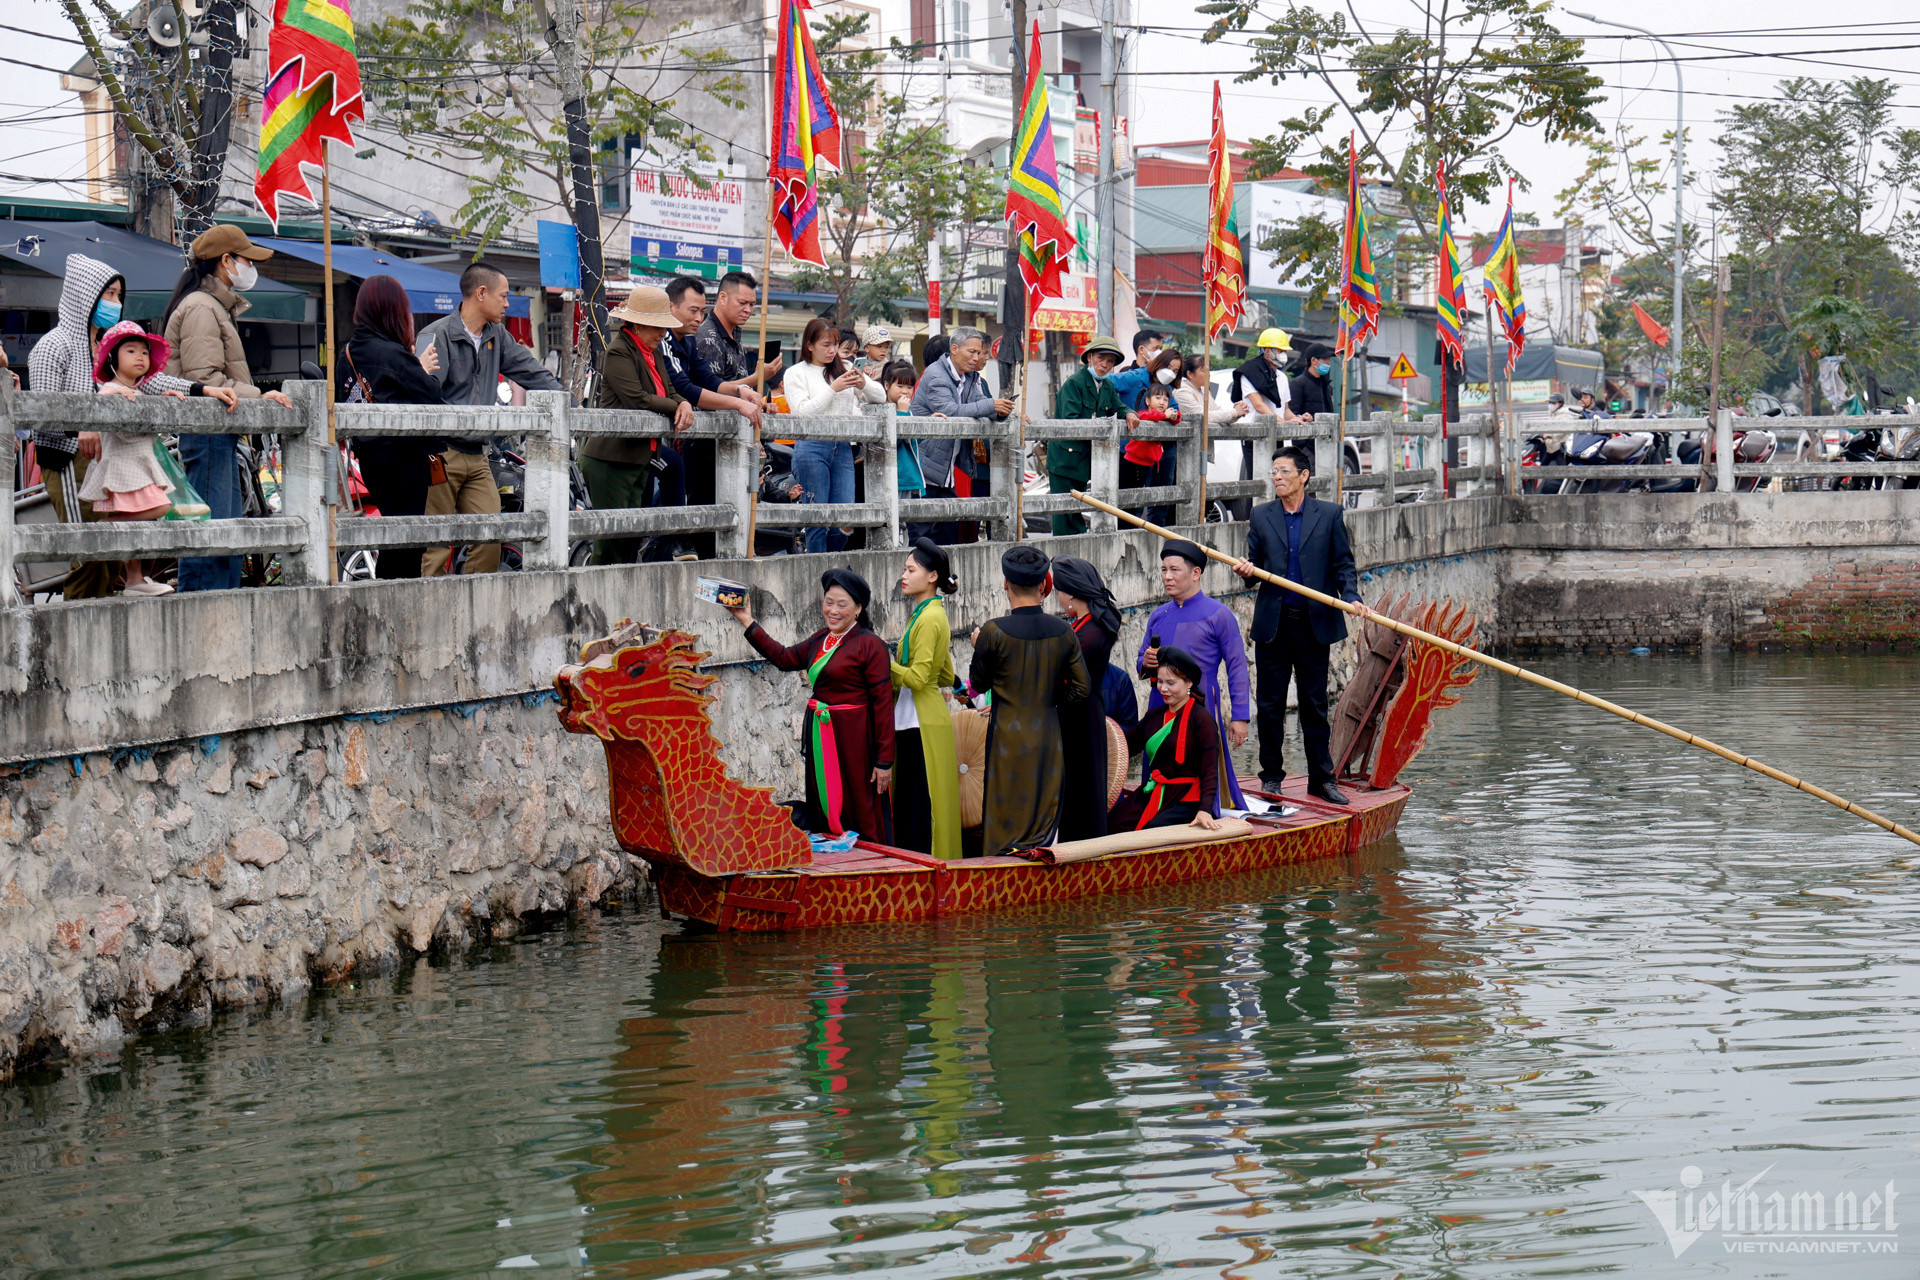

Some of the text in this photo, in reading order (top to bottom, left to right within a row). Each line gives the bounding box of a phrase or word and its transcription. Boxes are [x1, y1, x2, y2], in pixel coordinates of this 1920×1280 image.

[636, 167, 655, 194] NHÀ
[659, 170, 688, 198] UỐC
[675, 242, 704, 260] Salonpas
